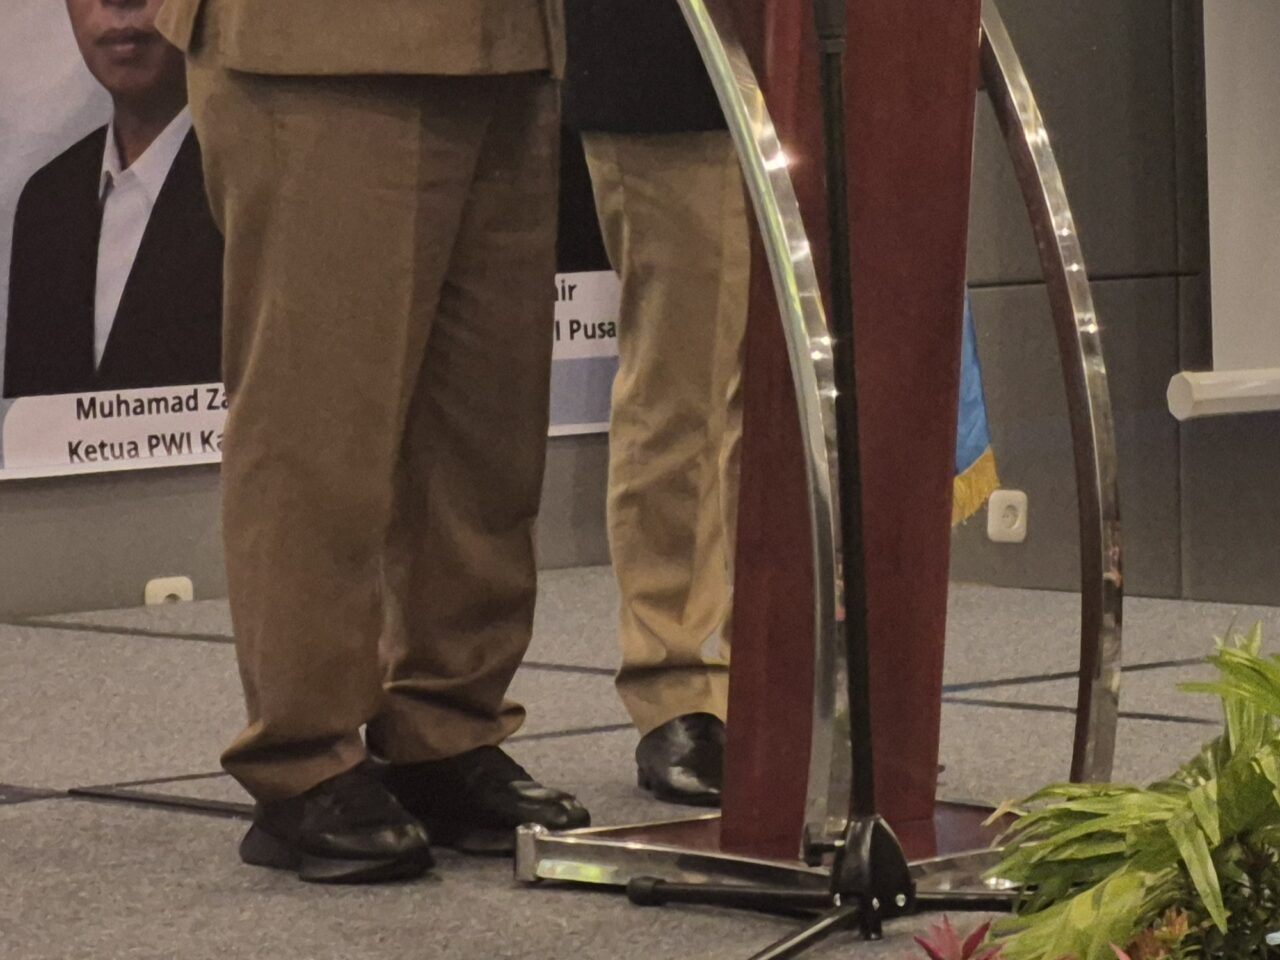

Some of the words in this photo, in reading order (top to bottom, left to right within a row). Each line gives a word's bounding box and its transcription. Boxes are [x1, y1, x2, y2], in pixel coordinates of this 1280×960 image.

[556, 278, 577, 302] ir
[76, 388, 199, 421] Muhamad
[68, 439, 140, 465] Ketua
[147, 431, 193, 457] PWI
